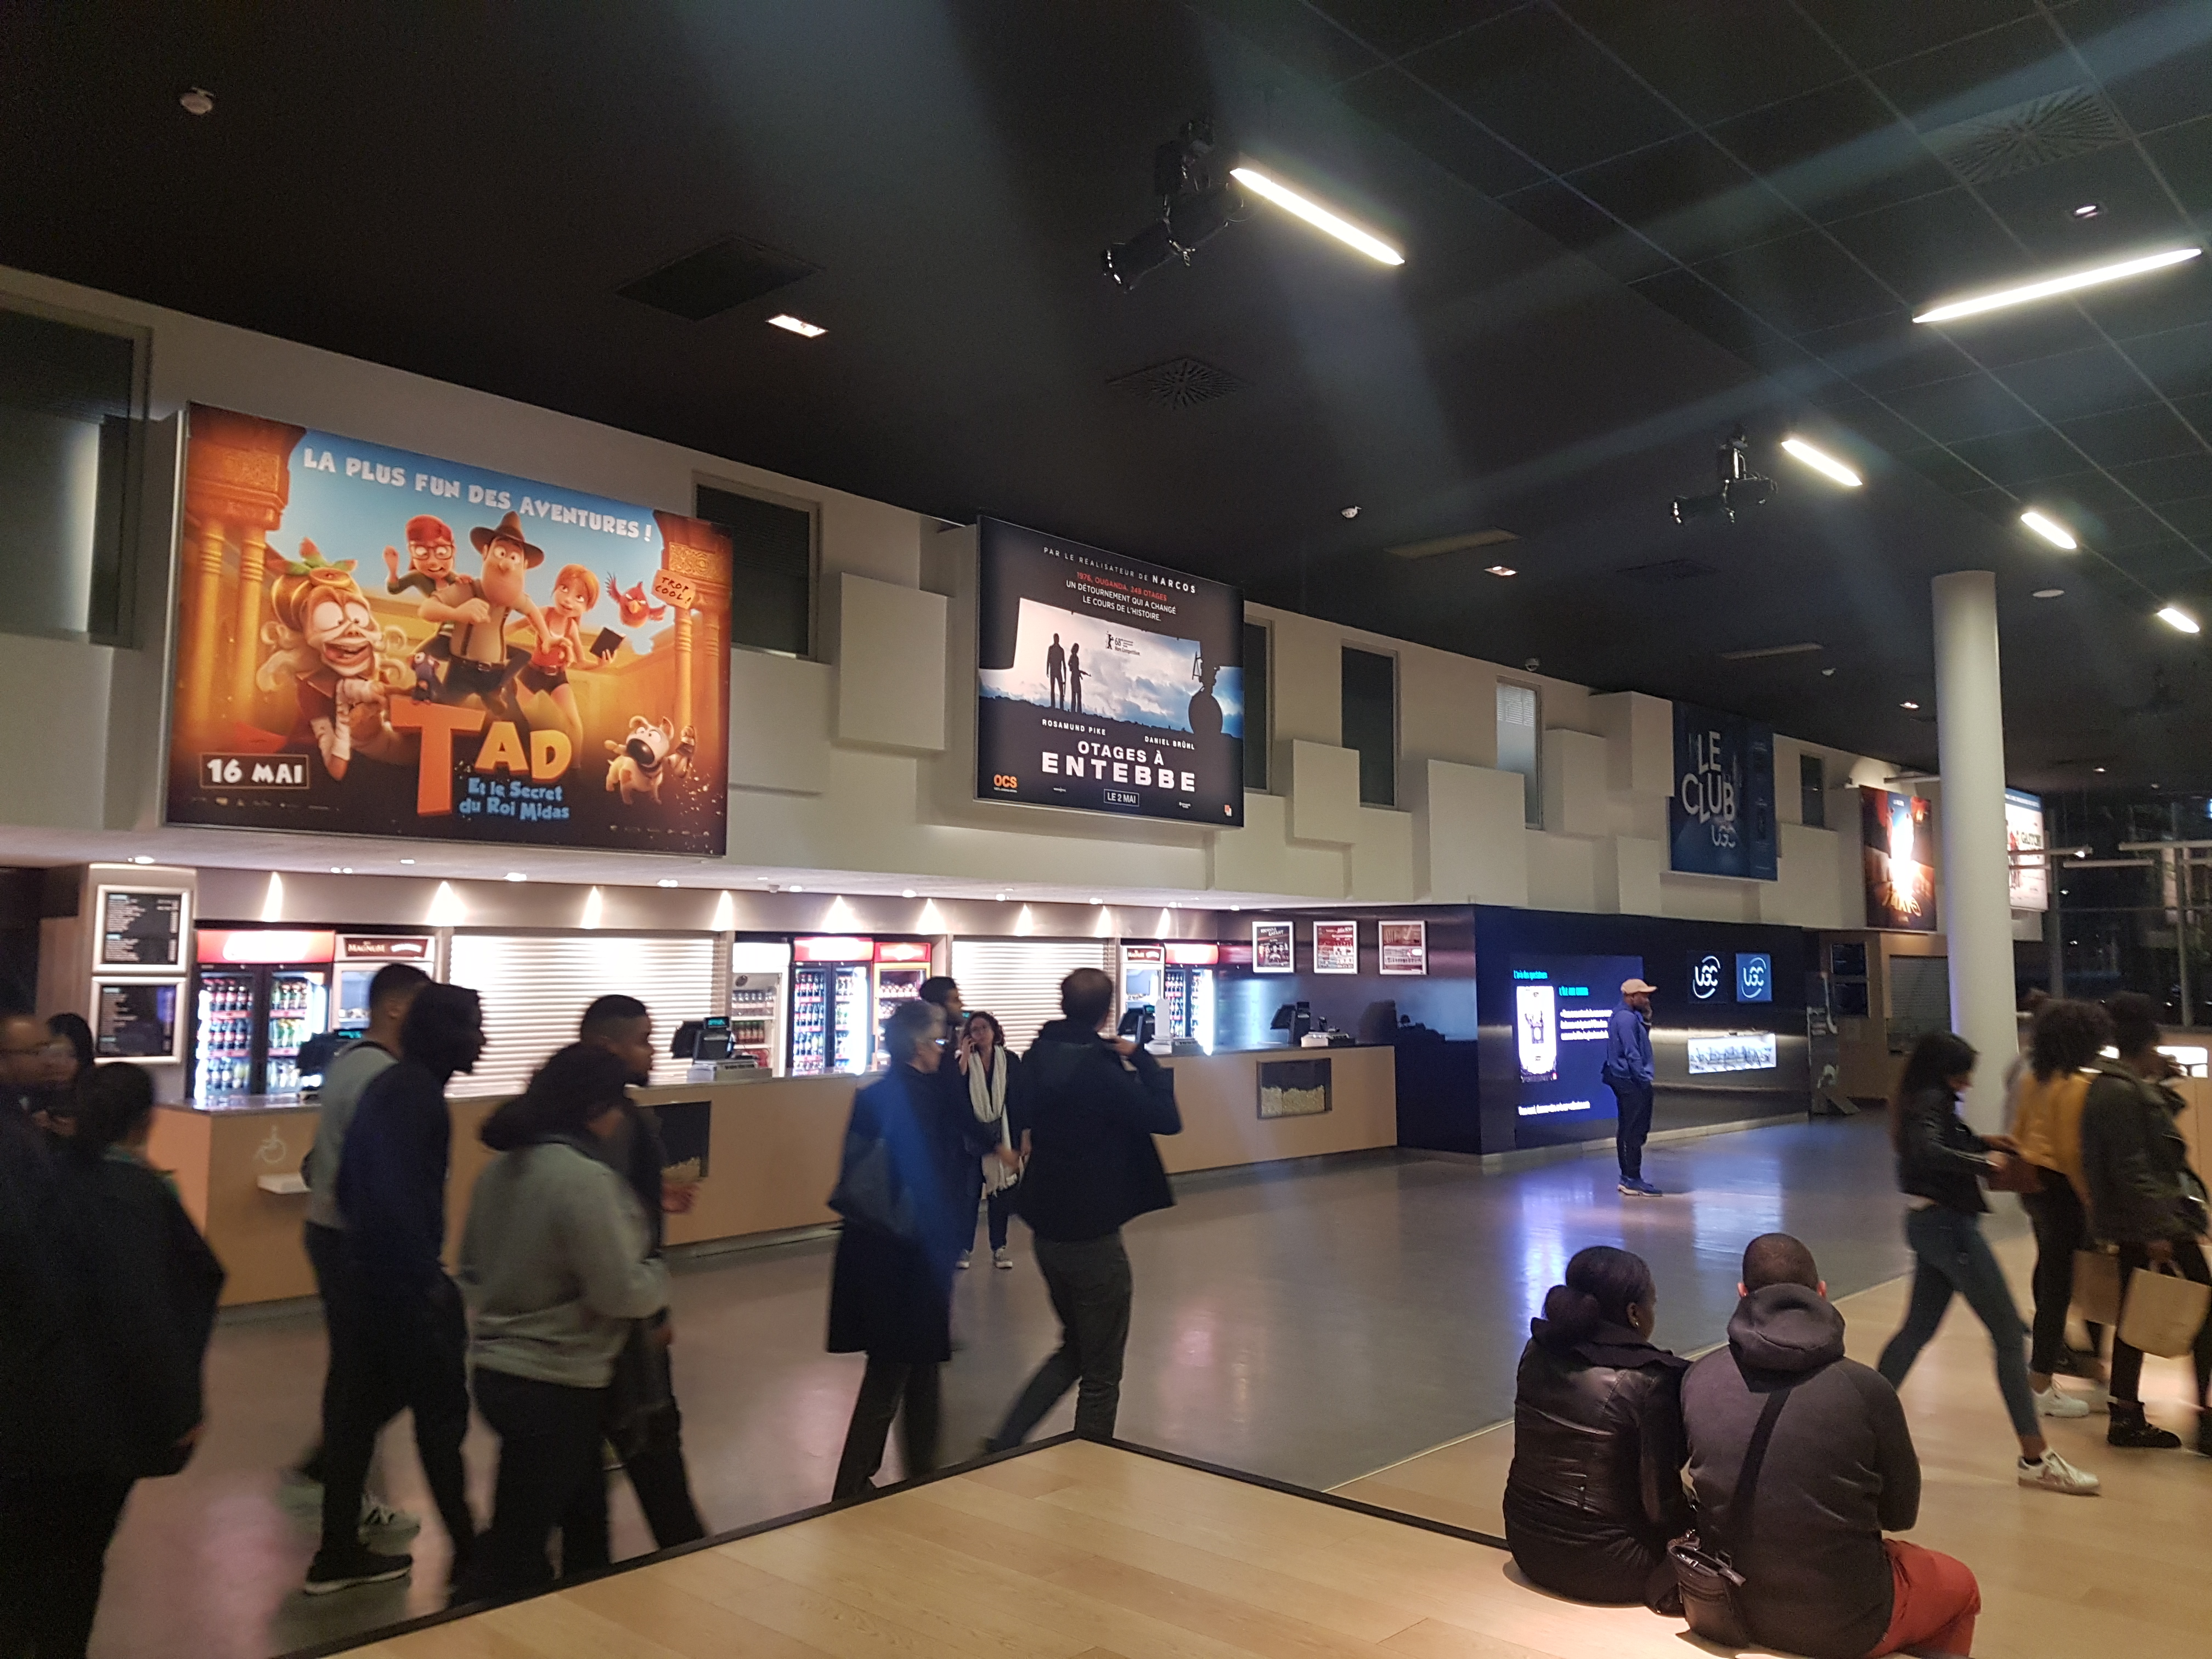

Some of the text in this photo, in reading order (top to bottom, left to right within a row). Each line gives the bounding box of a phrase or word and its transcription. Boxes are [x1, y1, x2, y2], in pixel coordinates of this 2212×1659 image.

[303, 448, 336, 473] LA
[346, 457, 406, 487] PLUS
[415, 473, 460, 498] FUN
[468, 484, 511, 510] DES
[519, 496, 640, 539] AVENTURES
[1043, 547, 1060, 557] PAR
[1064, 552, 1074, 561] LE
[1138, 573, 1148, 582] DE
[1152, 574, 1195, 594] NARCOS
[661, 577, 689, 592] TROP
[1143, 590, 1167, 602] OTAGES
[1066, 580, 1076, 589] UN
[1077, 583, 1130, 603] DÉTOURNEMENT
[1132, 597, 1143, 606] QUI
[1151, 601, 1177, 615] CHANGÉ
[1082, 595, 1091, 604] LE
[1092, 598, 1115, 610] COURS
[1116, 604, 1125, 613] DE
[1042, 719, 1106, 736] ROSAMUND PIKE
[1077, 741, 1164, 765] OTAGES À
[1144, 736, 1170, 746] DANIEL
[1698, 731, 1722, 775] LE
[390, 695, 572, 816] TAD
[207, 758, 303, 783] 16 MAI
[994, 774, 1018, 788] OCS
[1042, 752, 1195, 792] ENTEBBE
[468, 777, 487, 795] Et
[510, 780, 563, 802] Secret
[1107, 792, 1136, 804] LE 2 MAI
[1681, 772, 1735, 823] CLUB
[459, 797, 570, 821] du Roi Midas
[1695, 964, 1718, 986] UGC
[1743, 966, 1764, 986] UGC
